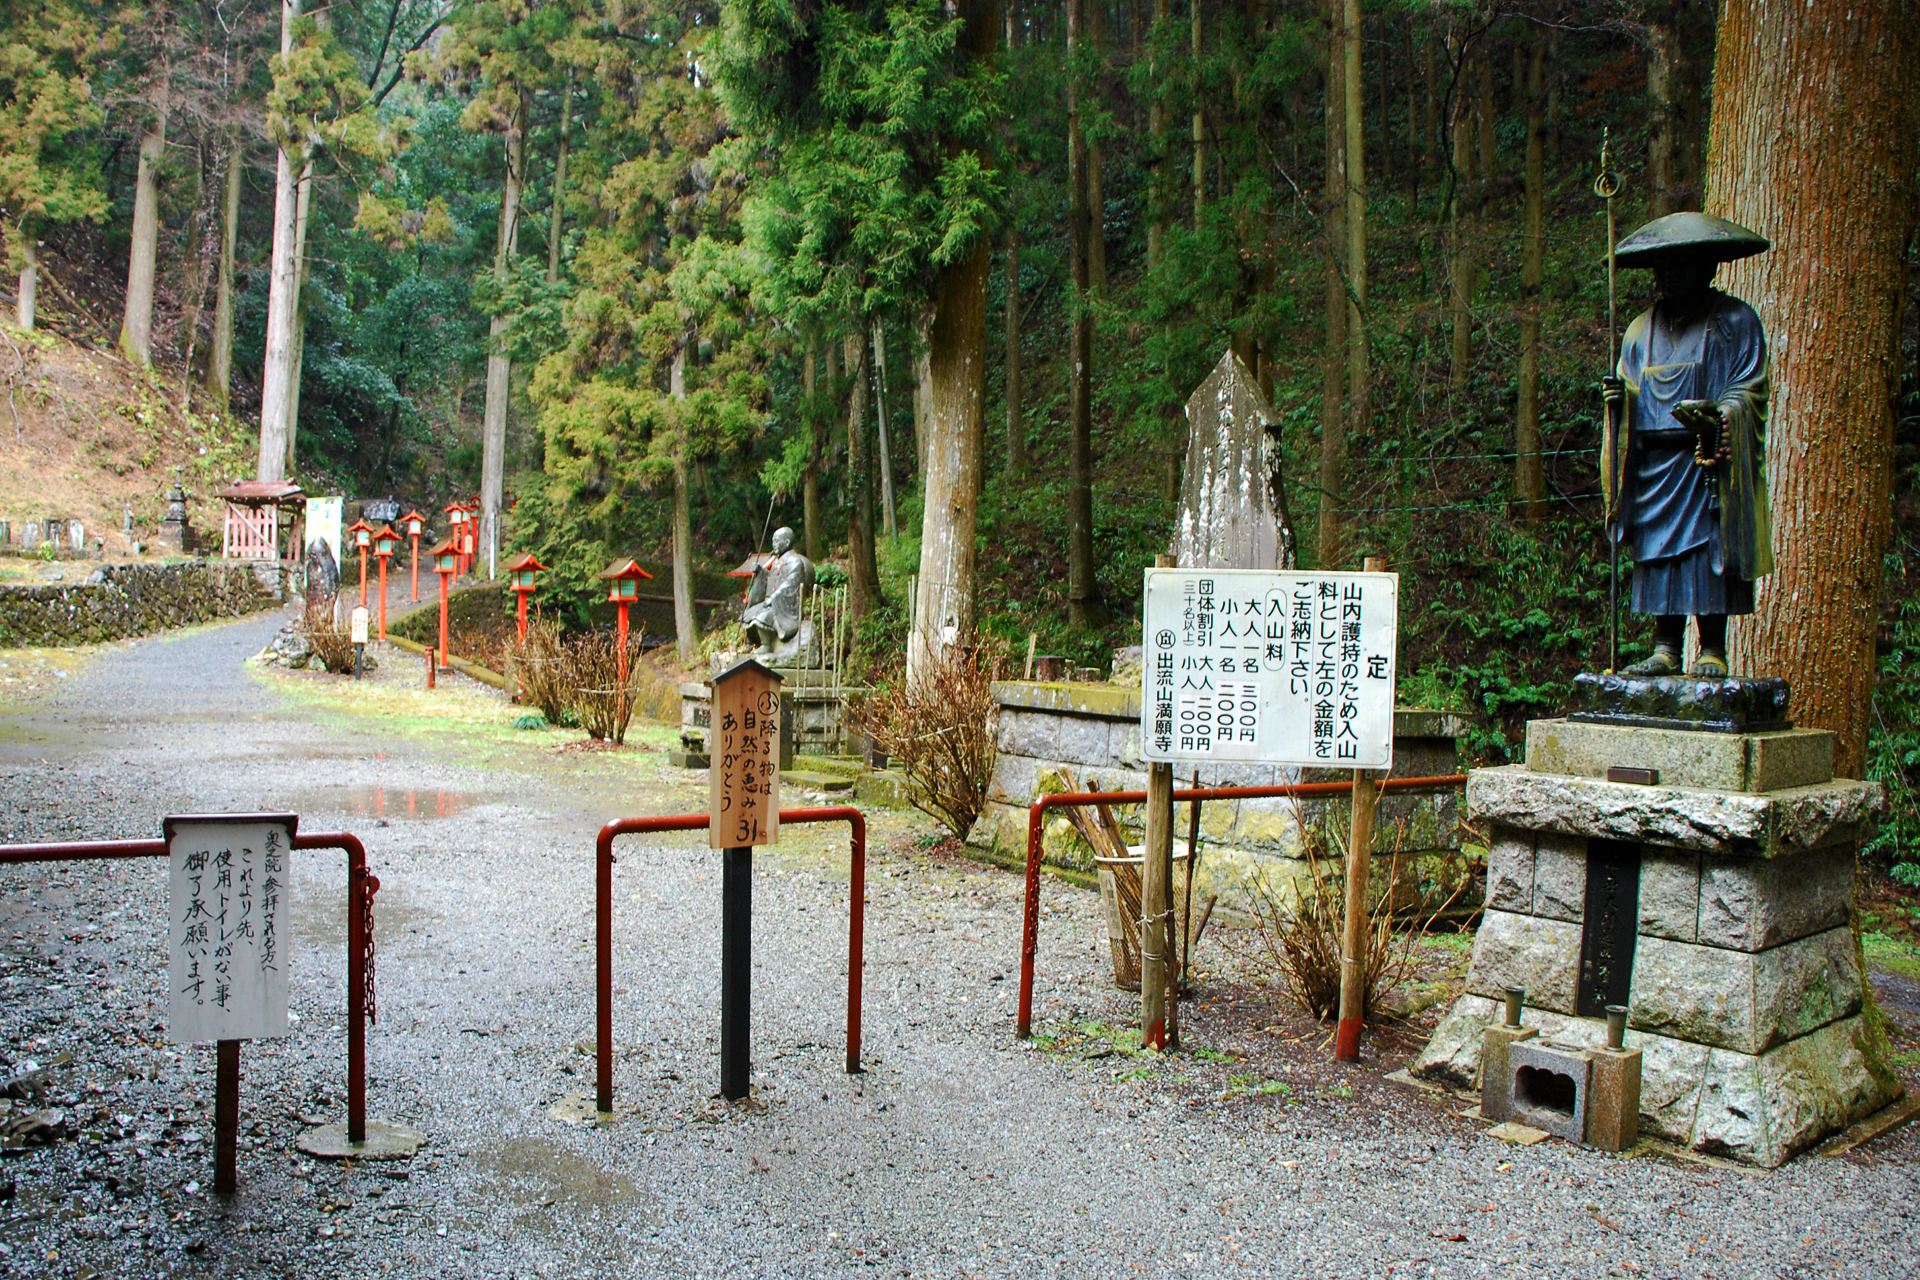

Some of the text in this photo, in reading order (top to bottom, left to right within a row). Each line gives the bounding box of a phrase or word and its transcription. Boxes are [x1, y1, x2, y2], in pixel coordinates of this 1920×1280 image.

[1197, 579, 1216, 647] 団体割引
[1265, 599, 1285, 662] 入山料
[1289, 580, 1314, 702] ご志納下さい。
[1154, 653, 1174, 753] 出流山満願寺
[1313, 581, 1339, 759] 料として左の金額を
[1337, 582, 1363, 760] 山内護持のため入山
[1366, 655, 1388, 680] 定
[720, 710, 742, 812] ありがとう
[740, 707, 759, 809] 自然の恵み
[759, 719, 778, 796] 降る物は
[736, 818, 758, 842] 31
[181, 850, 214, 1006] 御了承願います。
